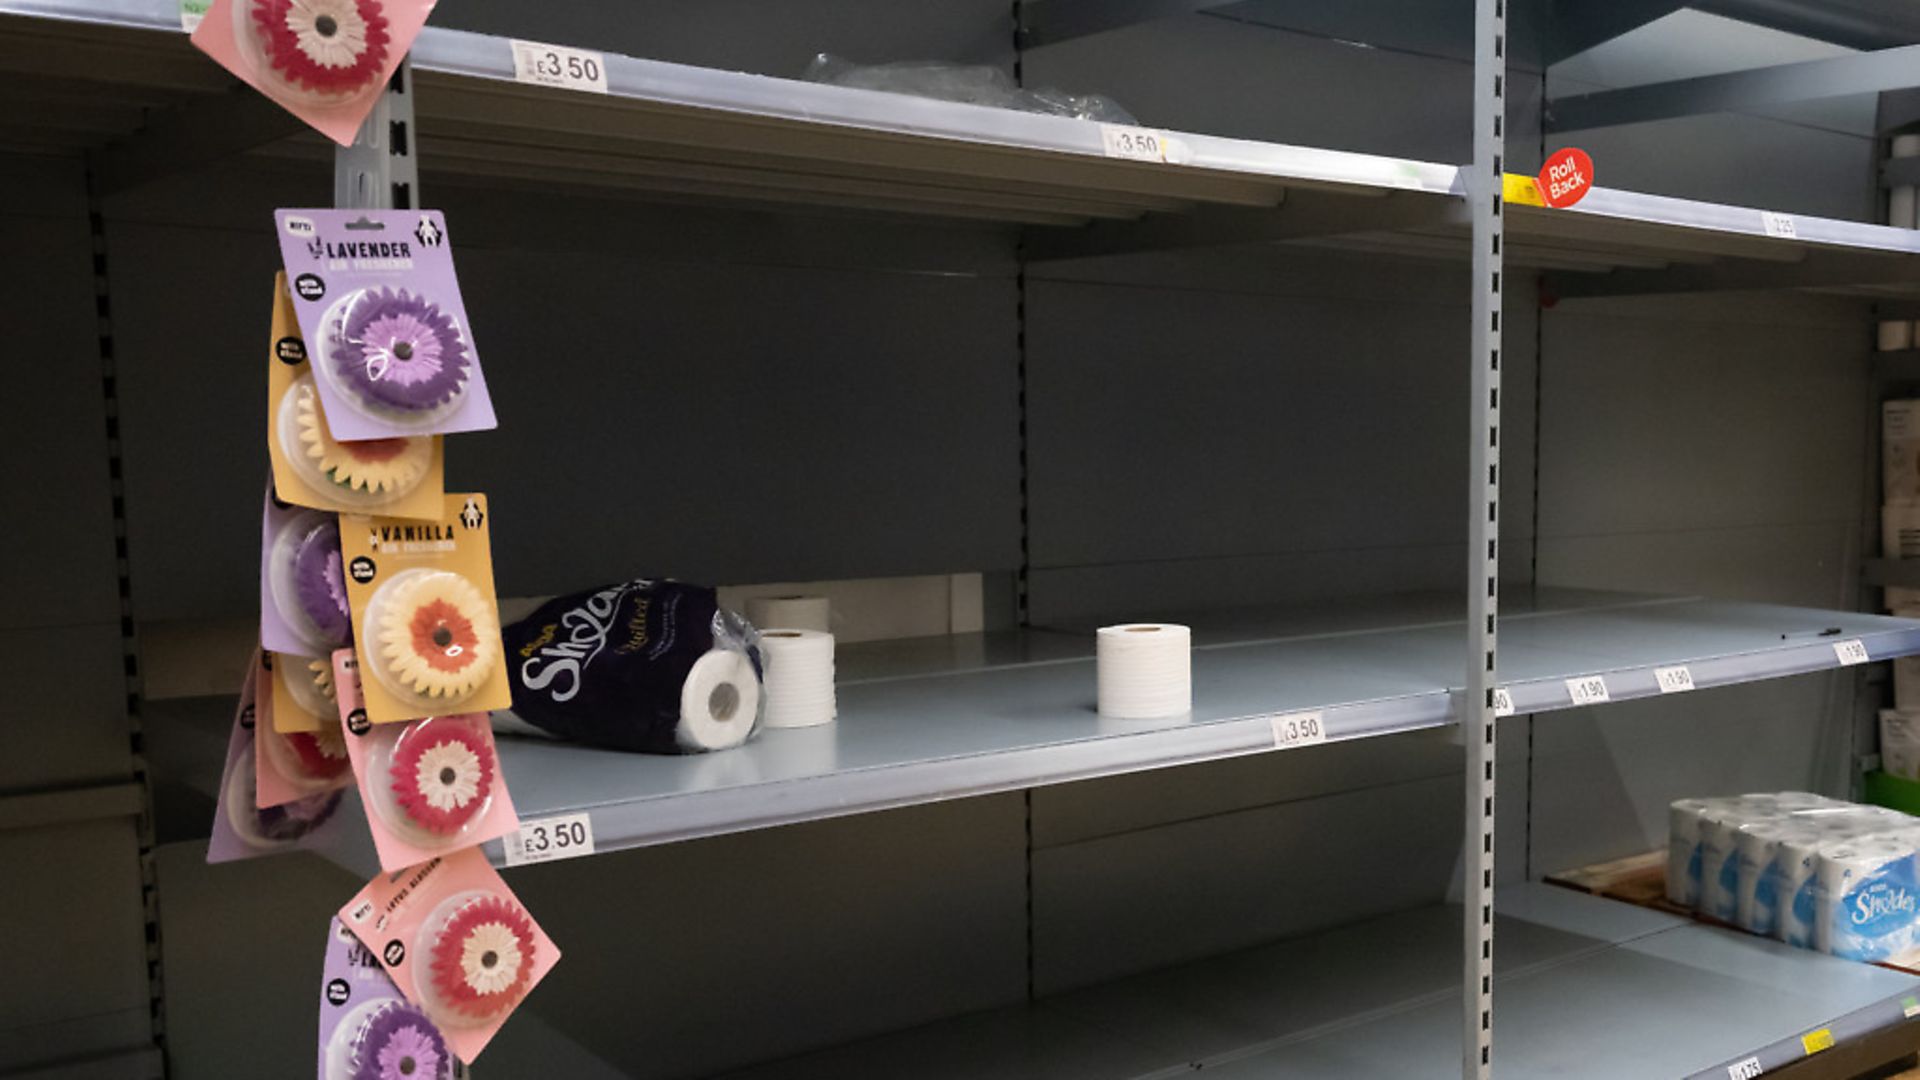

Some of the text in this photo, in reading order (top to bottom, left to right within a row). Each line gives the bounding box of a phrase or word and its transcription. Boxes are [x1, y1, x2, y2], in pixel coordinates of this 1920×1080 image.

[536, 52, 600, 82] £3.50
[1549, 156, 1577, 182] Roll
[1549, 172, 1586, 200] Back
[326, 241, 412, 259] LAVENDER
[381, 525, 455, 541] VANILLA
[524, 821, 586, 853] £3.50
